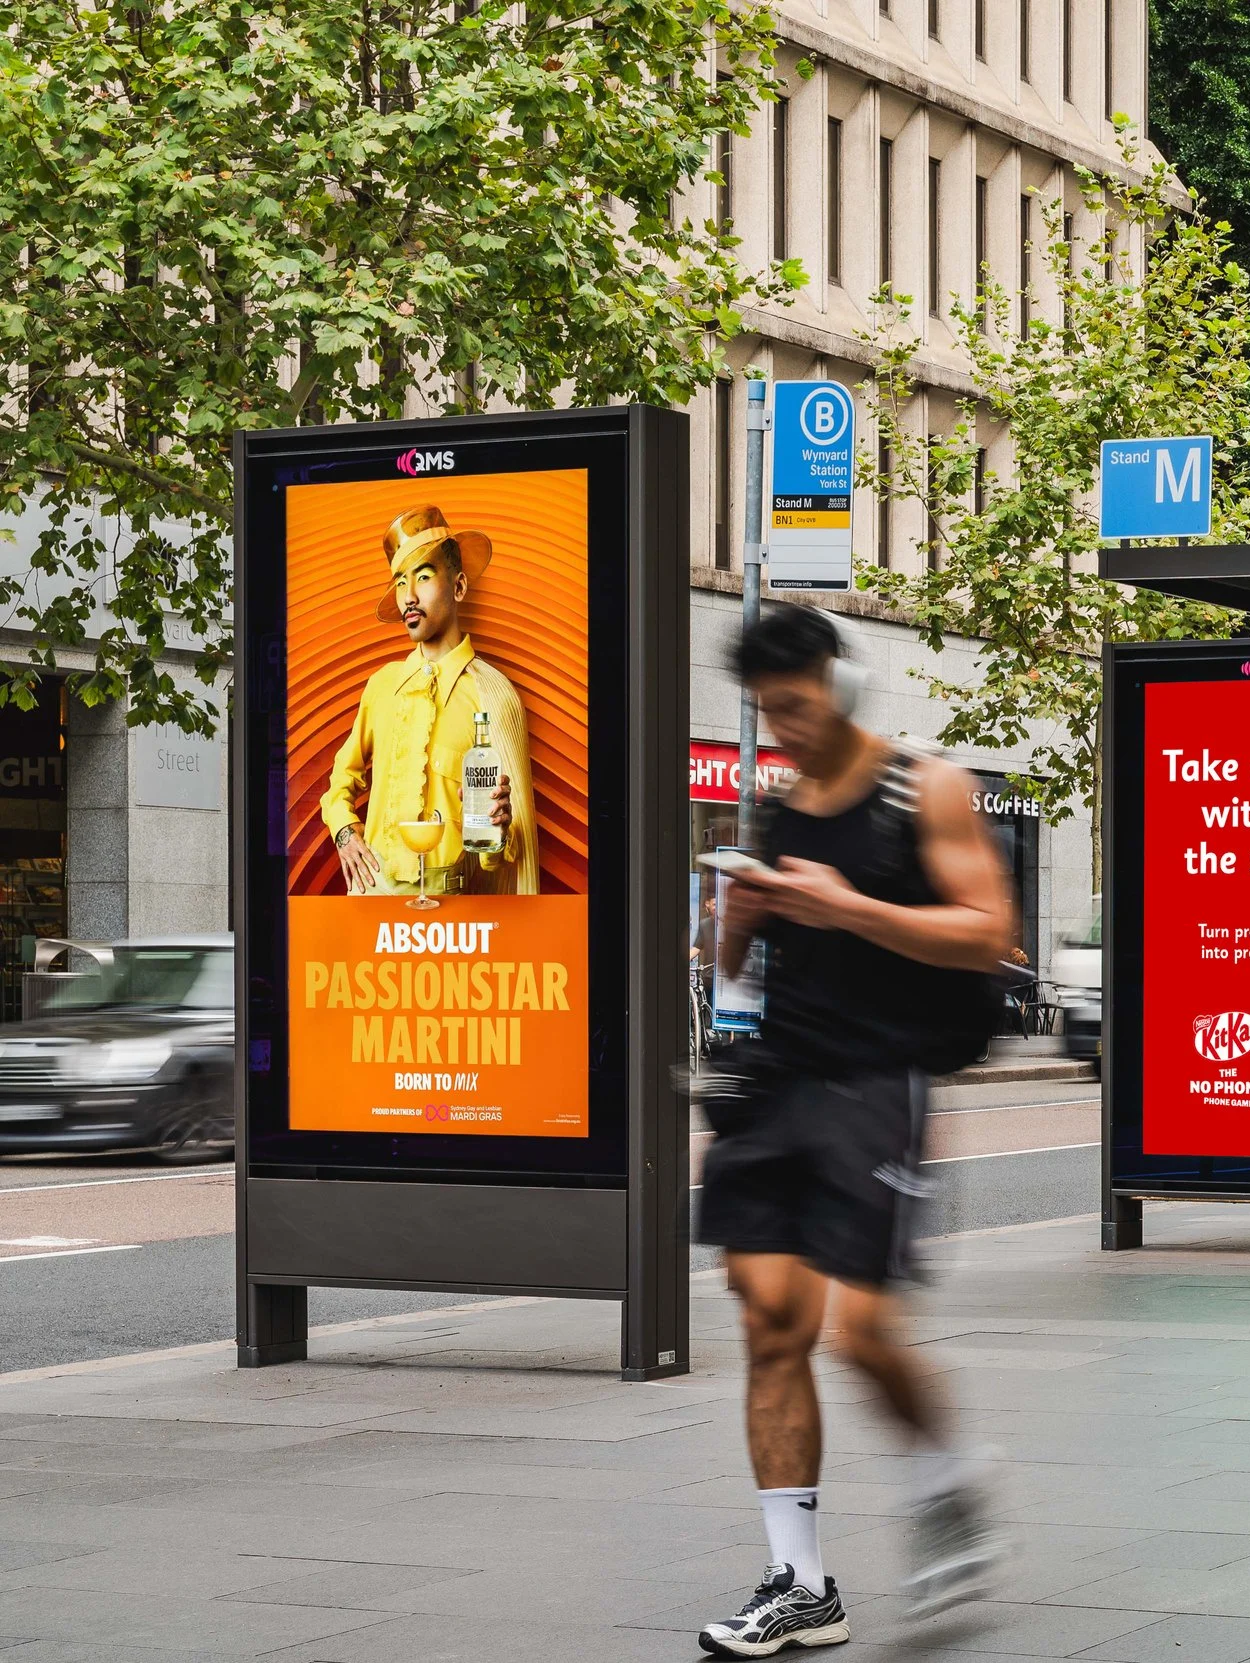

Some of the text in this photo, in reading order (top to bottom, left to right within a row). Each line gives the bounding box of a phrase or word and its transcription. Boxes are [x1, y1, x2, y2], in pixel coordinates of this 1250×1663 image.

[815, 401, 835, 433] B
[406, 448, 455, 475] QMS
[802, 449, 848, 463] Wynyard
[810, 464, 848, 476] Station
[1110, 447, 1202, 503] Stand M
[819, 480, 847, 489] York St
[775, 498, 812, 509] Stand M
[775, 515, 793, 525] BN1
[157, 749, 200, 772] Street
[1162, 748, 1239, 782] Take
[465, 766, 498, 777] ABSOLUT
[466, 777, 497, 788] VANILIA
[984, 792, 1039, 817] COFFEE
[1184, 841, 1237, 874] the
[1198, 923, 1229, 938] Turn
[1201, 945, 1229, 959] into
[305, 960, 571, 1011] PASSIONSTAR
[351, 1015, 521, 1065] MARTINI
[1219, 1068, 1237, 1078] THE
[394, 1072, 479, 1092] BORN TO MIX
[1189, 1080, 1211, 1094] NO
[1203, 1097, 1230, 1106] PHONE
[371, 1107, 422, 1116] PROUD PARTNERS OF
[450, 1111, 503, 1121] MARDI GRAS
